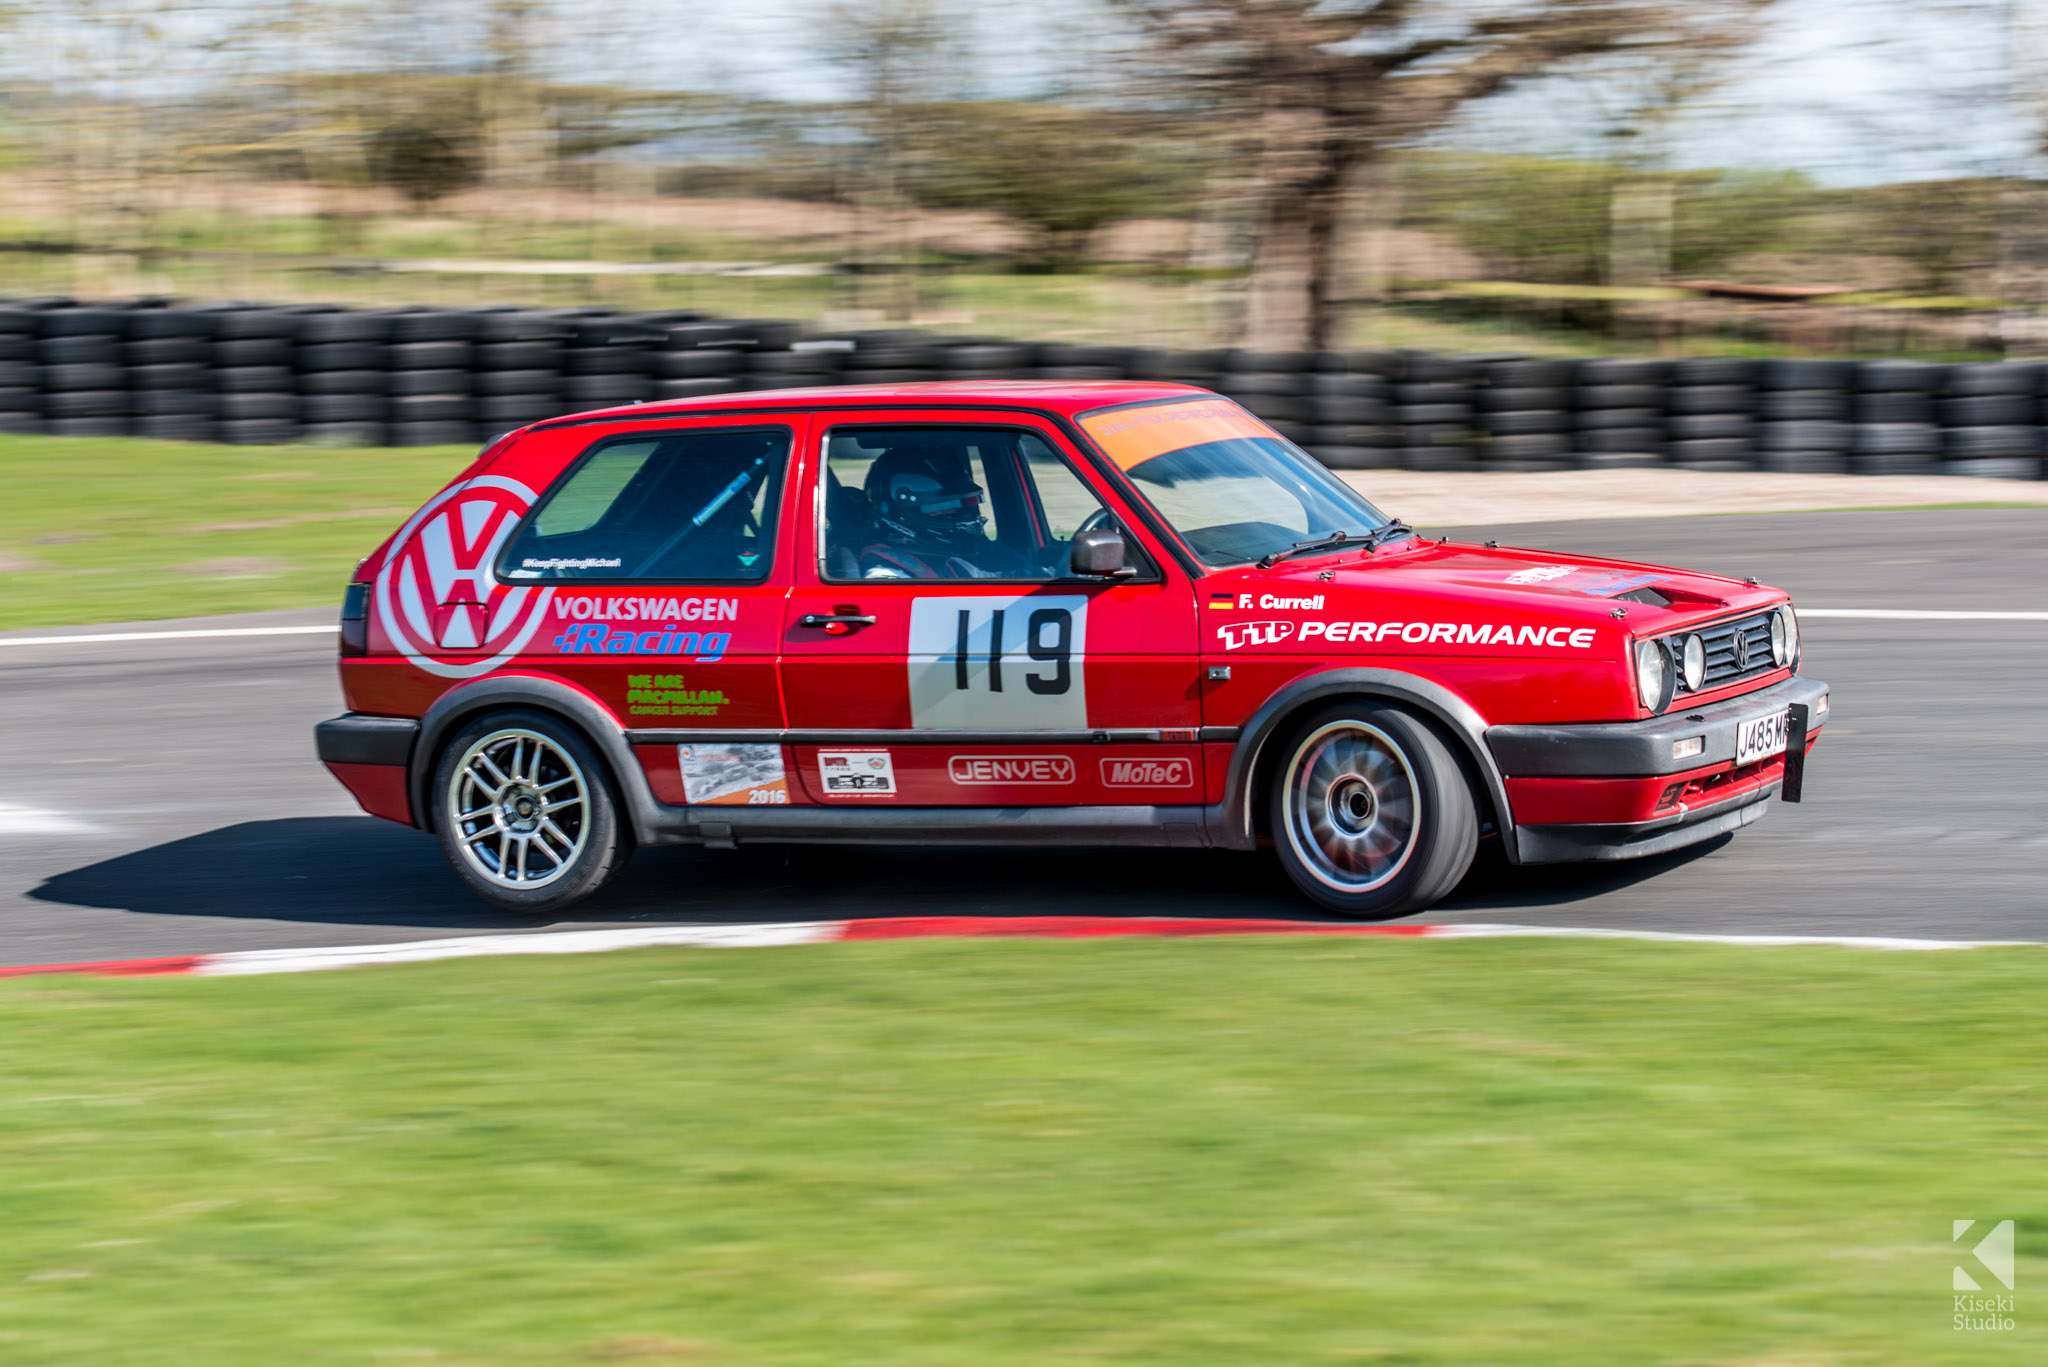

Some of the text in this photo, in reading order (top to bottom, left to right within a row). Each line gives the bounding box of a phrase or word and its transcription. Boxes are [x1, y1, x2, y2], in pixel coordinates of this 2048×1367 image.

[554, 597, 739, 621] VOLKSWAGEN
[1238, 594, 1325, 610] F. Currell
[573, 623, 732, 662] Racing
[1298, 621, 1596, 649] PERFORMANCE
[956, 608, 1072, 695] 119
[627, 674, 685, 689] WE ARE
[955, 760, 1070, 780] JENVEY
[1111, 763, 1183, 783] MoTeC
[748, 789, 786, 804] 2016
